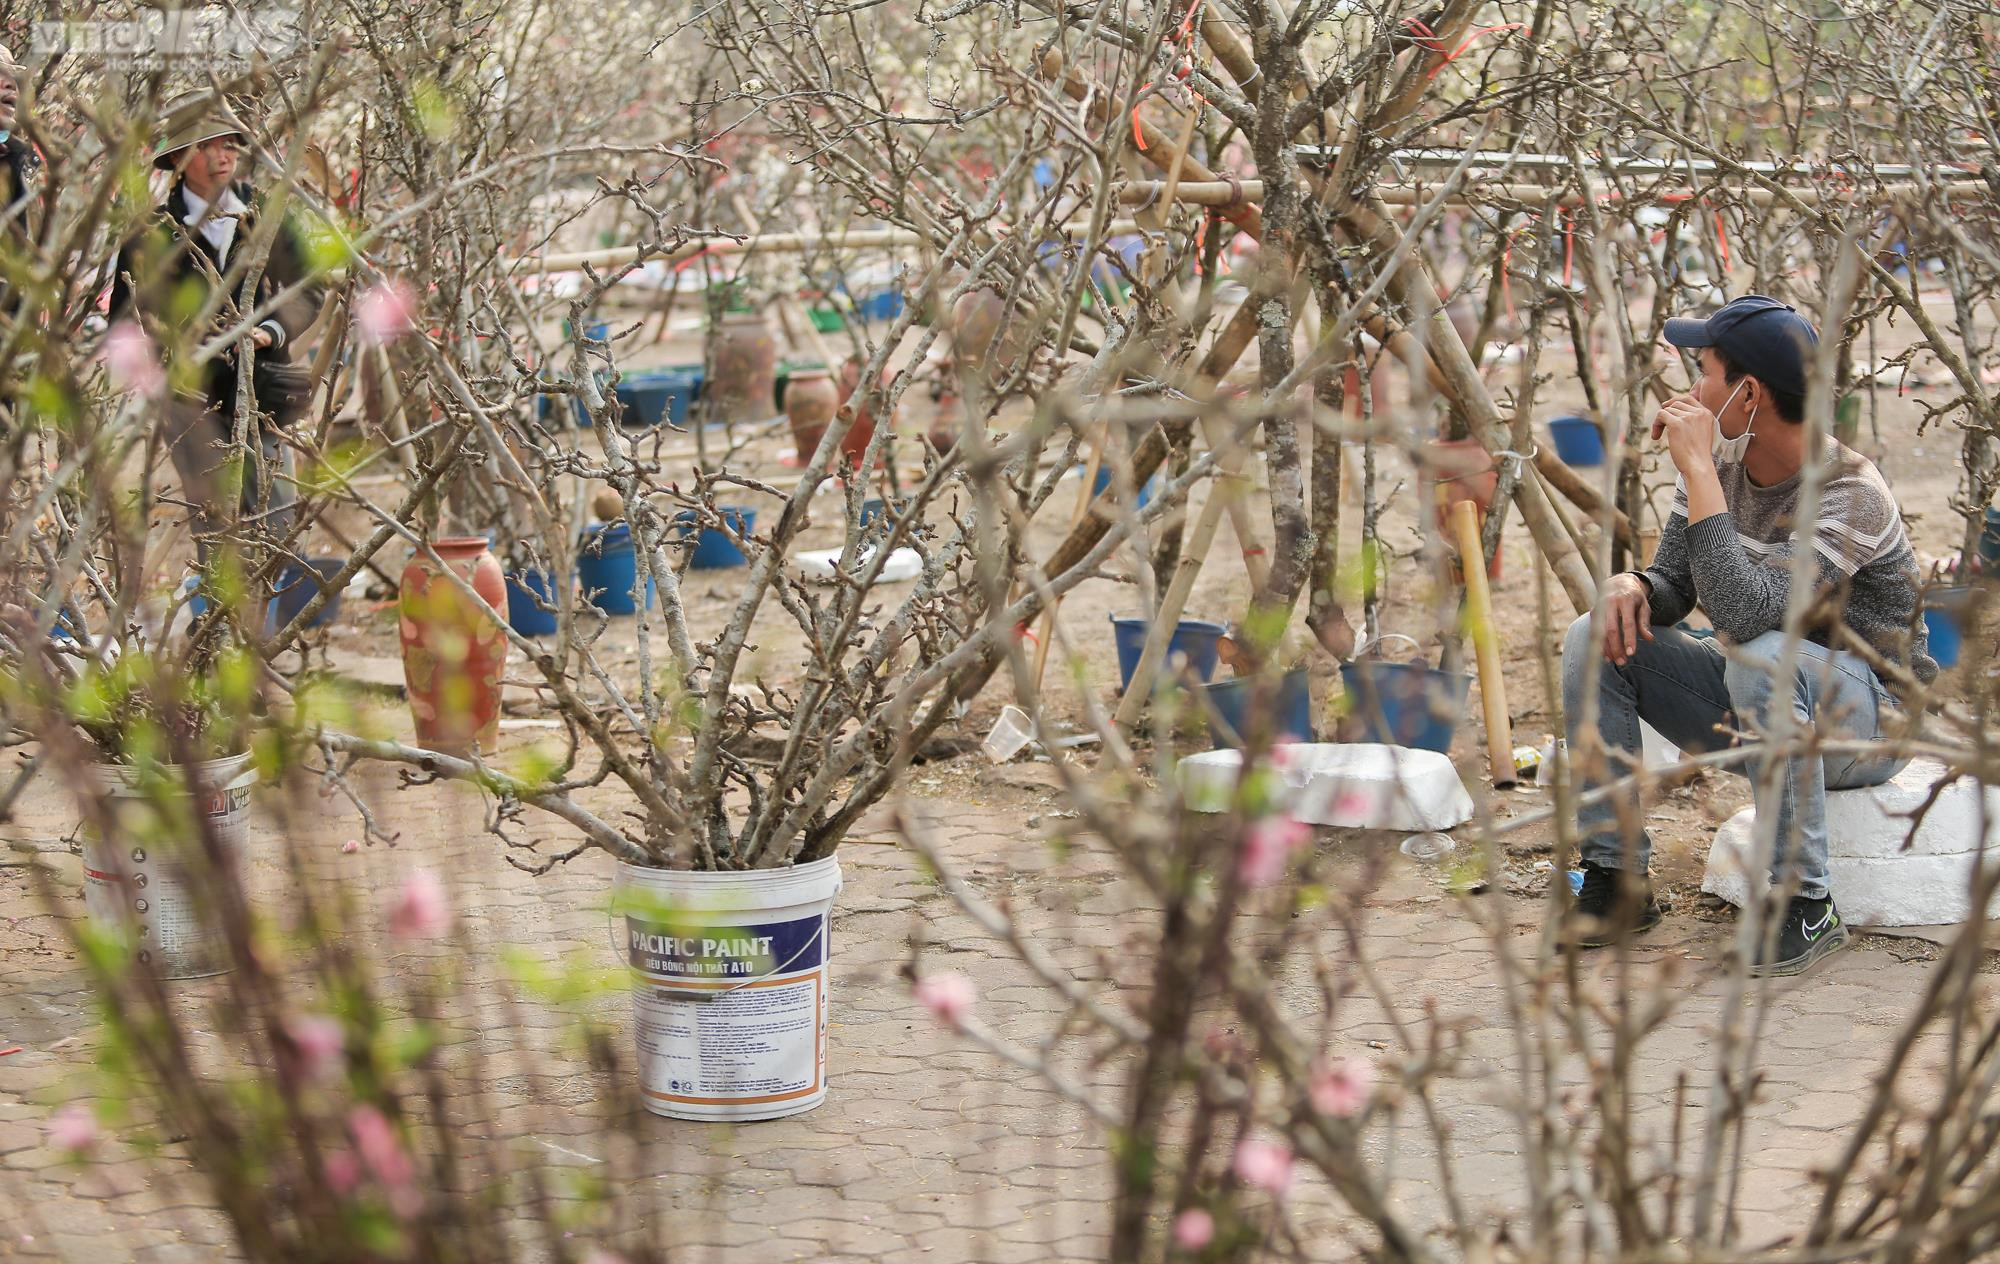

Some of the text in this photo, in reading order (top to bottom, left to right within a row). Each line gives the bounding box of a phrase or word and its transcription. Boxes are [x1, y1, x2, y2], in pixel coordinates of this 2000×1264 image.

[631, 930, 774, 957] PACIFIC PAINT
[662, 959, 685, 973] BÓNG
[705, 960, 730, 974] THẤT
[730, 961, 753, 974] A10
